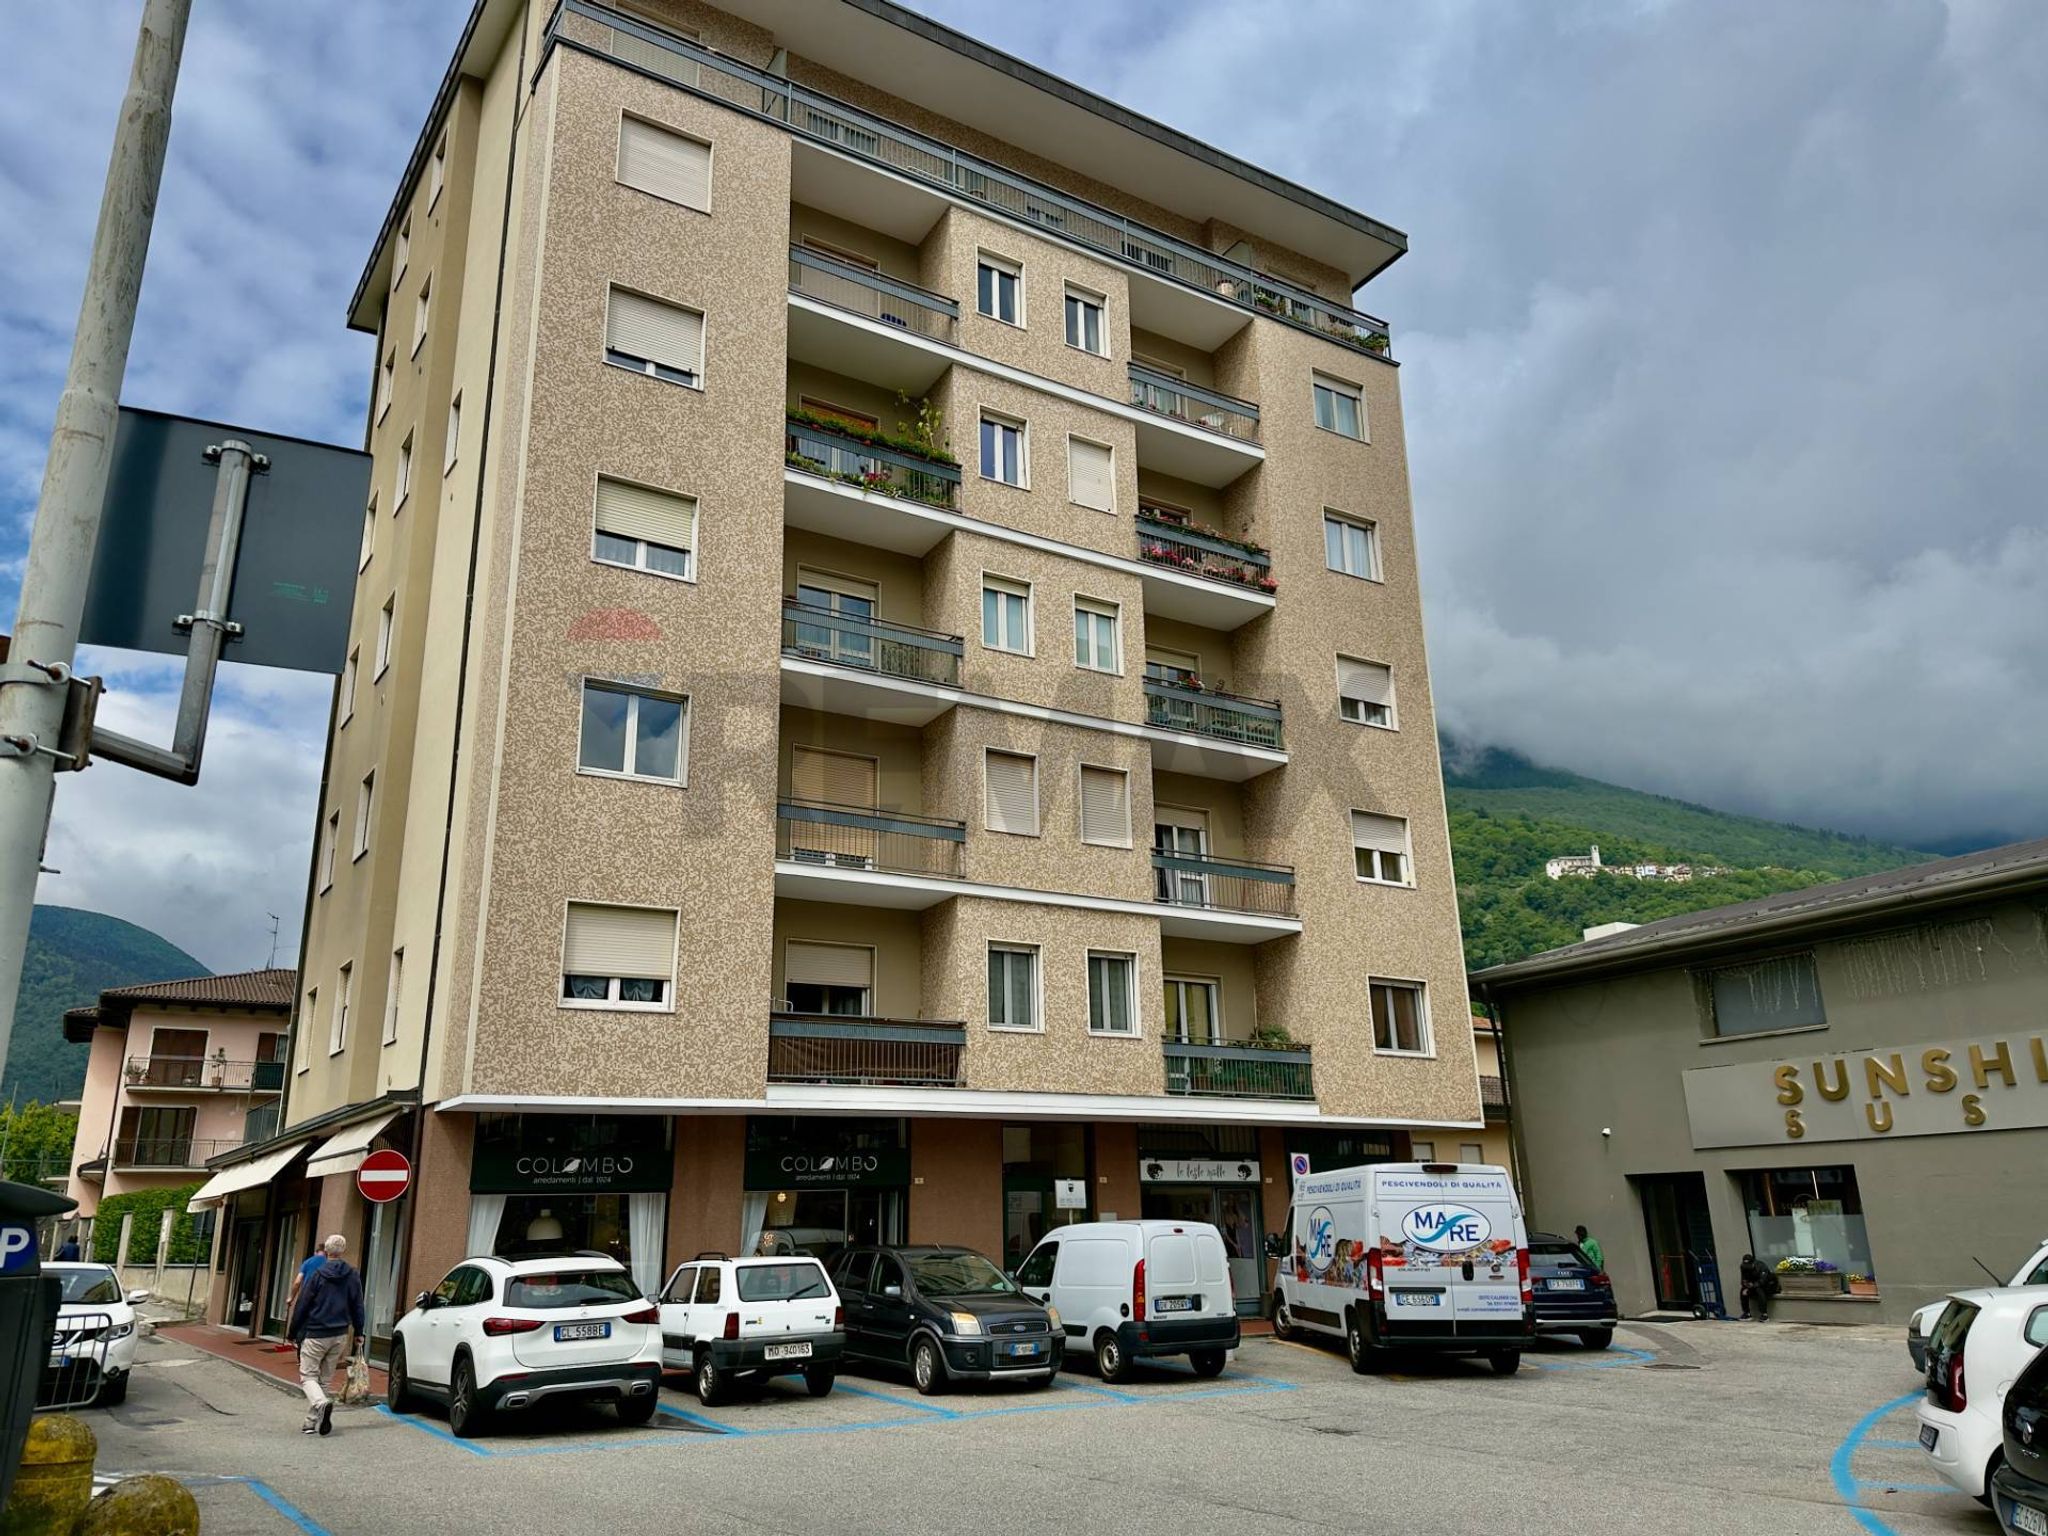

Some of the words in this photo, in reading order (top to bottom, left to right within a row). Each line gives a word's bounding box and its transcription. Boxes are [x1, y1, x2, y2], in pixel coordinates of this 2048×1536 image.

[517, 1157, 633, 1174] COLOMBO
[780, 1156, 878, 1172] COLOMBO
[1382, 1180, 1448, 1188] PESCIVENDOLI
[1451, 1180, 1460, 1188] DI
[0, 1227, 30, 1269] P
